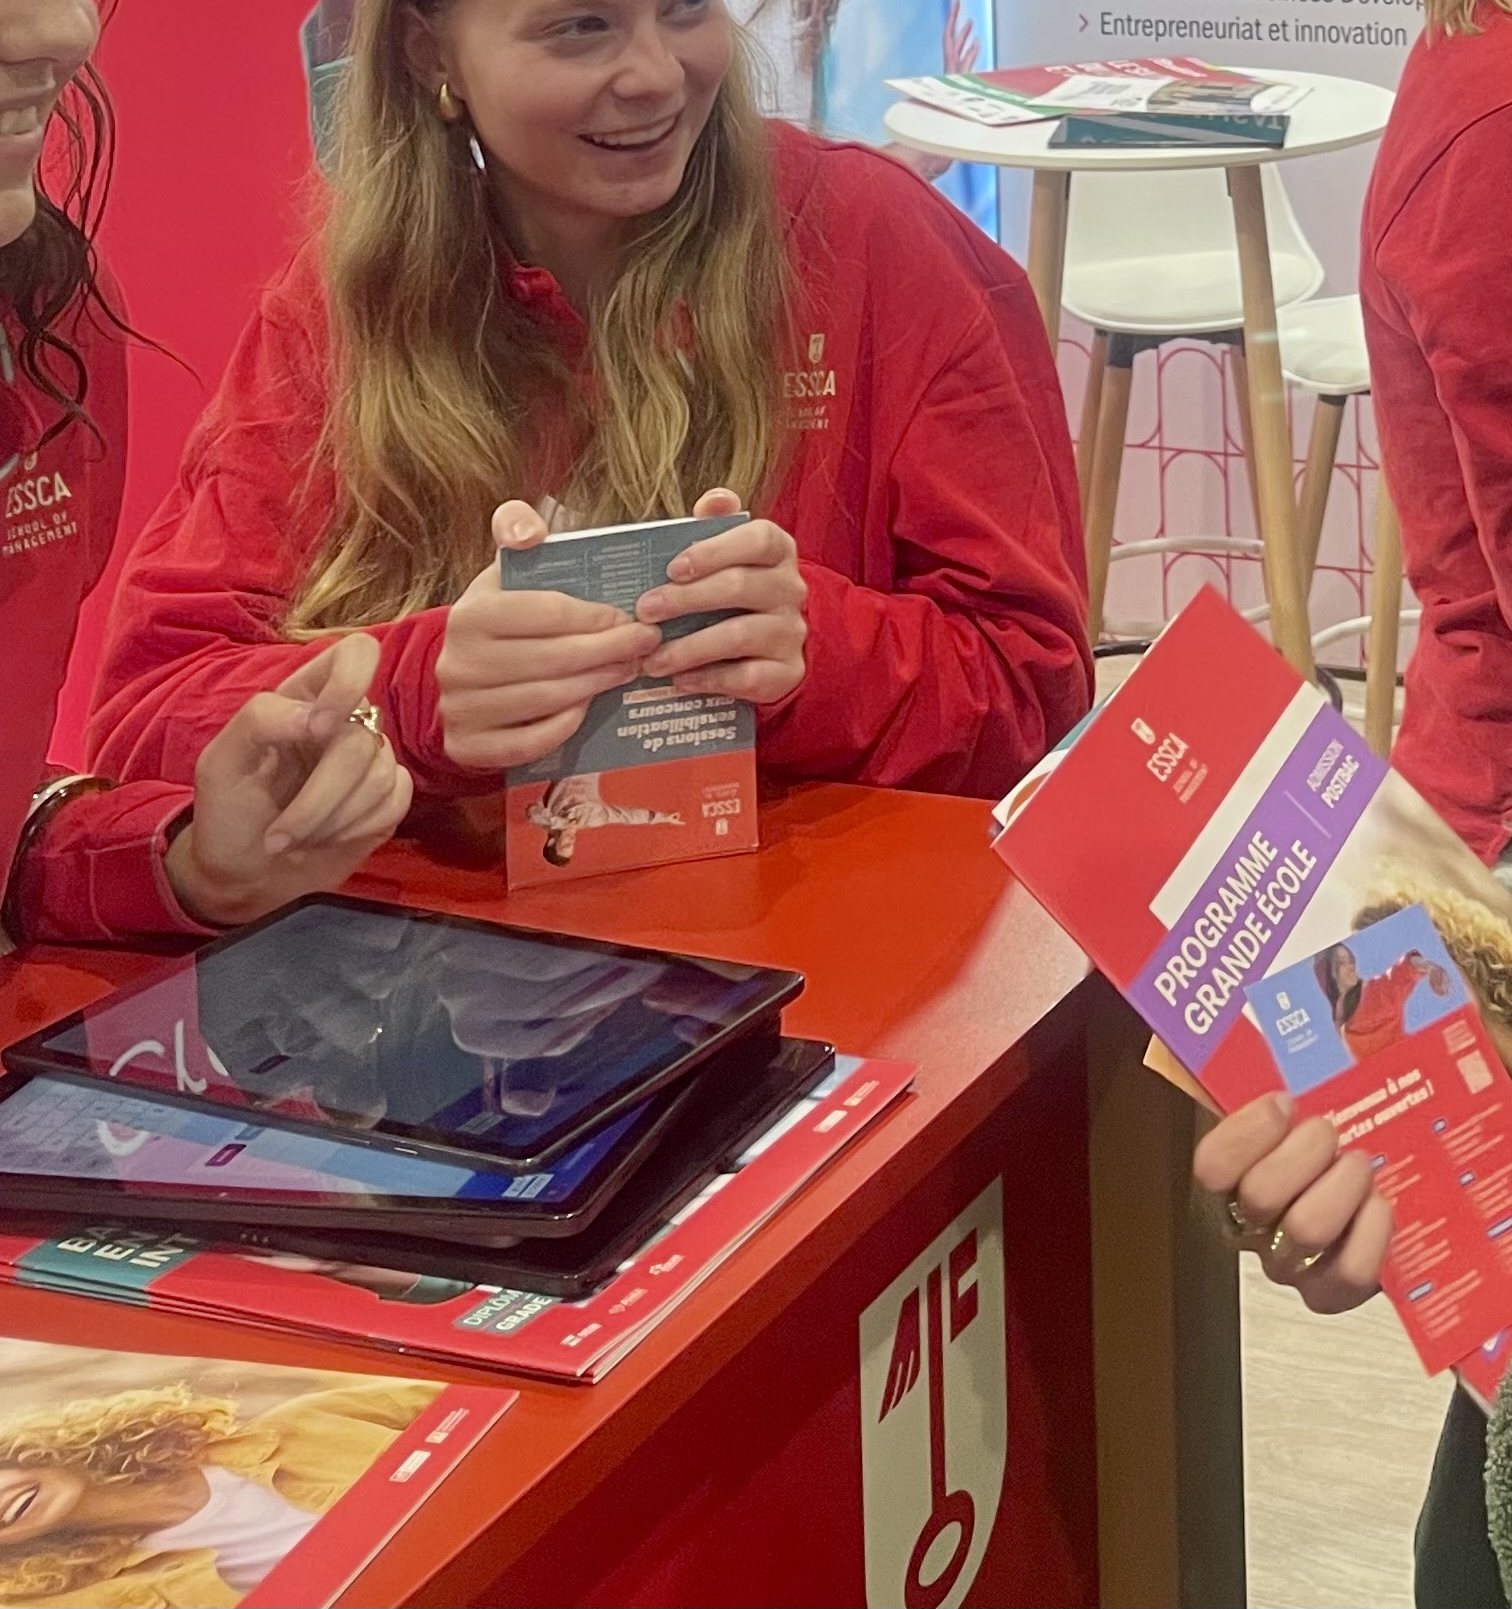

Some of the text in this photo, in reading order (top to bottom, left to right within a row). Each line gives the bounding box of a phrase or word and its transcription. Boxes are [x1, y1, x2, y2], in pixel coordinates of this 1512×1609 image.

[1099, 11, 1408, 47] Entrepreneuriat et innovation
[617, 710, 737, 739] sensibilisation
[628, 698, 703, 720] concours
[643, 725, 737, 753] Sessions de
[1146, 732, 1189, 782] ESSCA
[1321, 754, 1360, 809] POSTBAC
[1153, 831, 1278, 1007] PROGRAMME
[1183, 839, 1318, 1035] GRANDE ÉCOLE
[463, 1289, 524, 1326] DIPLÔM
[496, 1296, 553, 1331] GRADE
